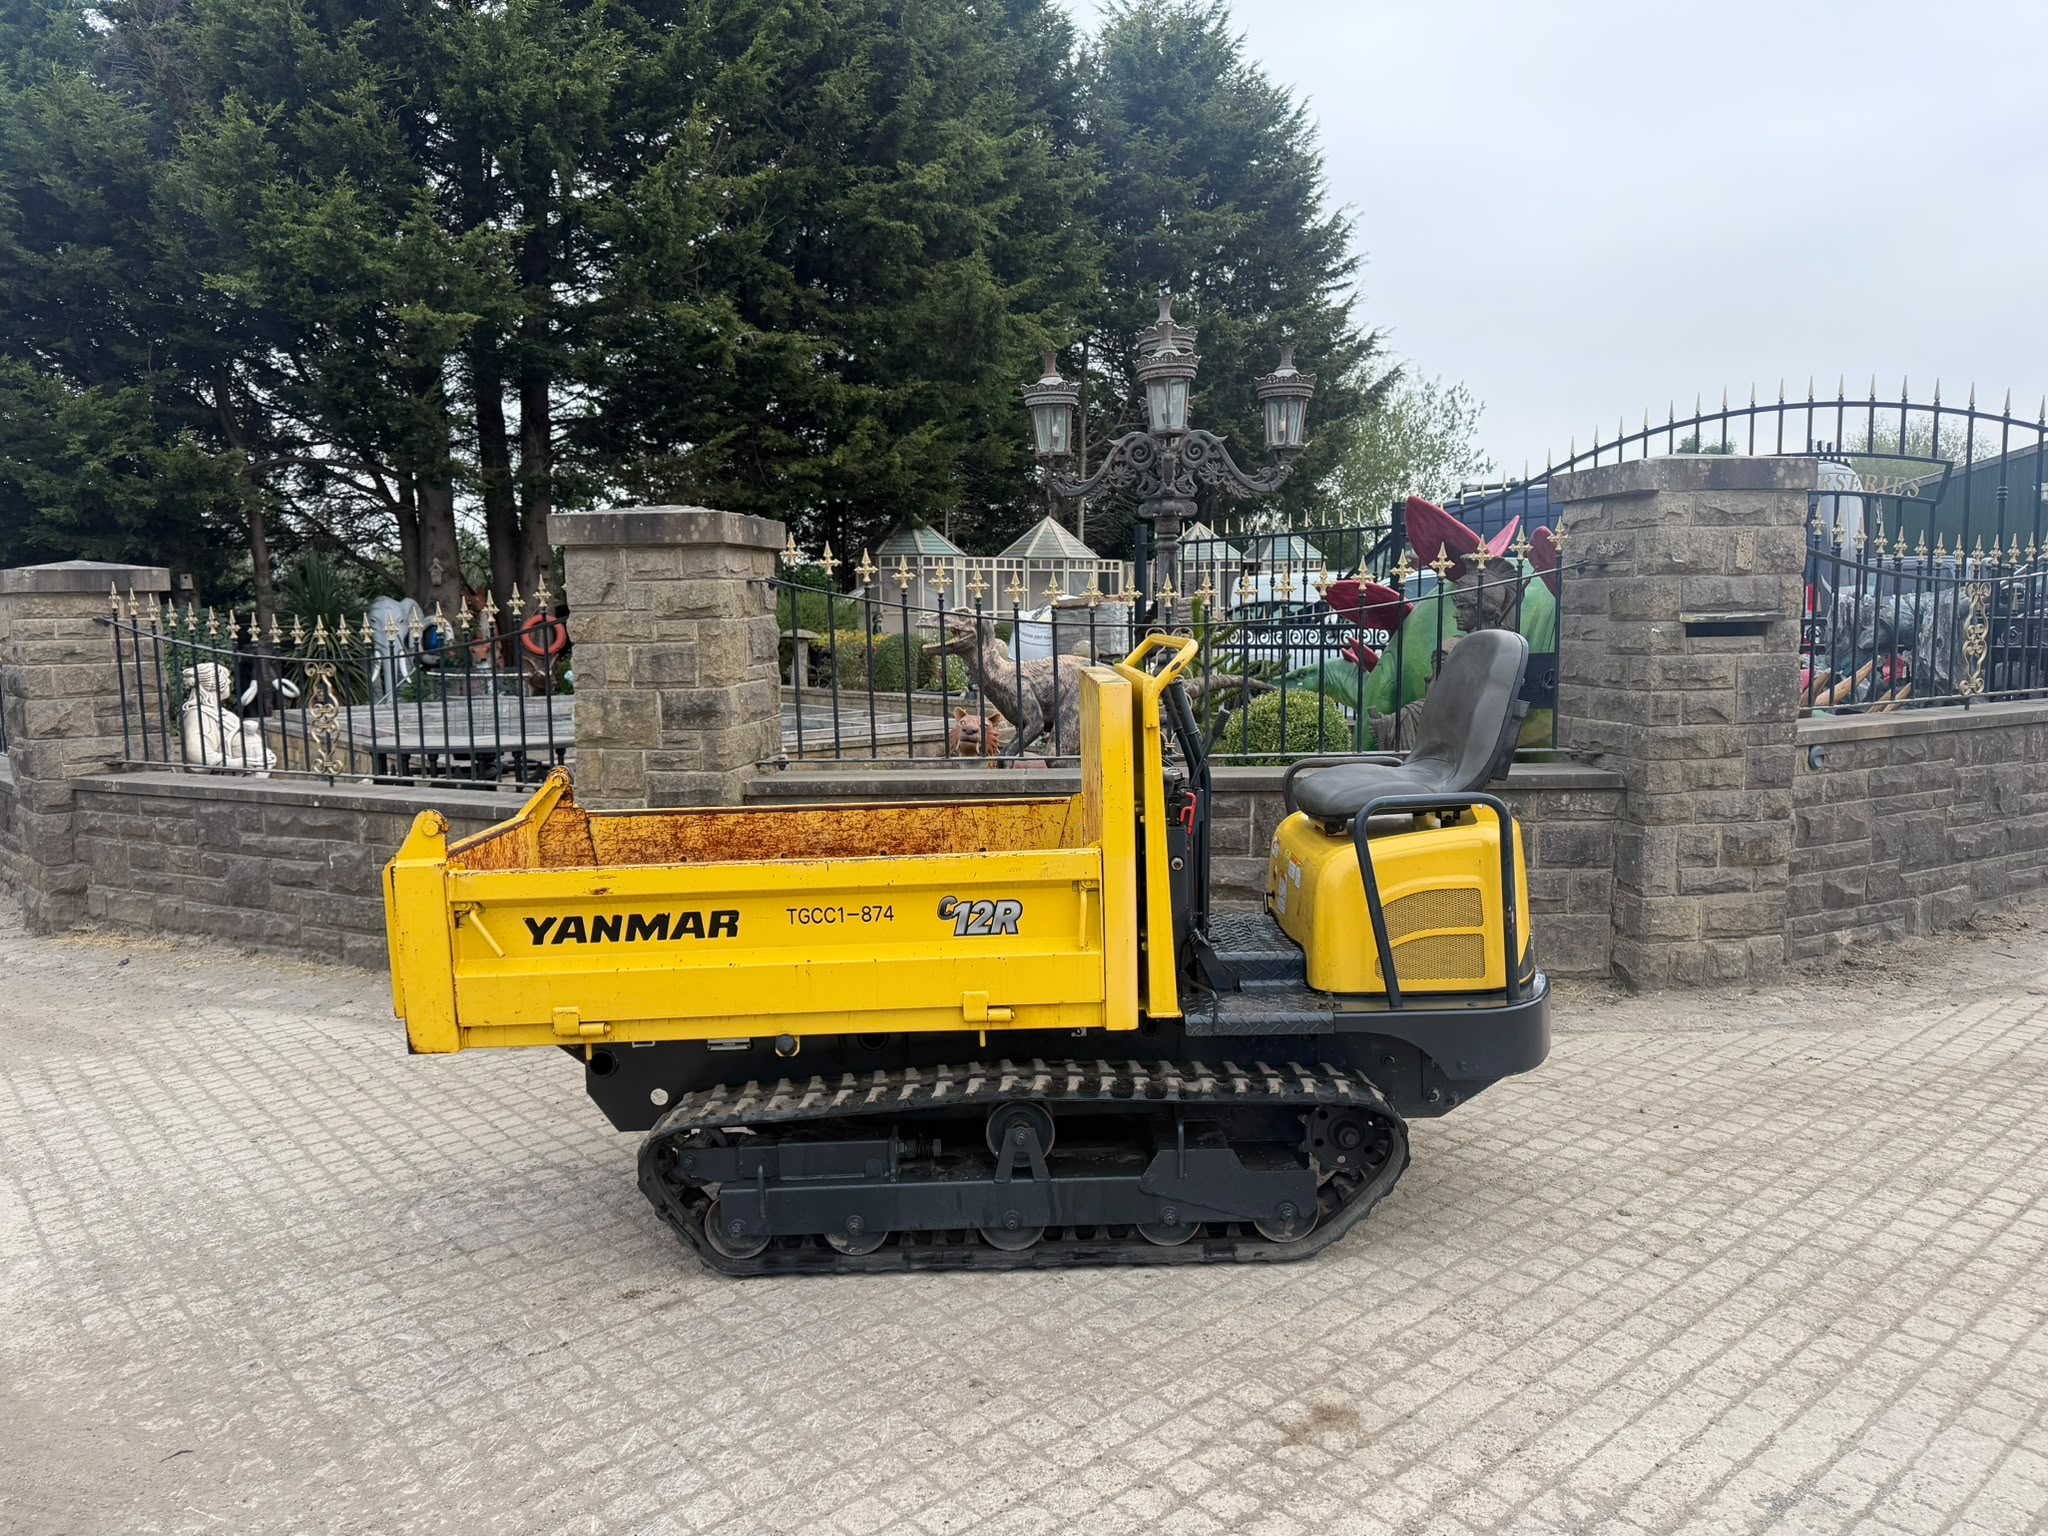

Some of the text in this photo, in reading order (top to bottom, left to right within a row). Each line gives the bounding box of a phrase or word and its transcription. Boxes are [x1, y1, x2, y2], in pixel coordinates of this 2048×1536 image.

[1819, 473, 1921, 498] RSERIES
[523, 910, 740, 945] YANMAR
[786, 905, 895, 925] TGCC1-874
[937, 896, 1023, 936] C12R
